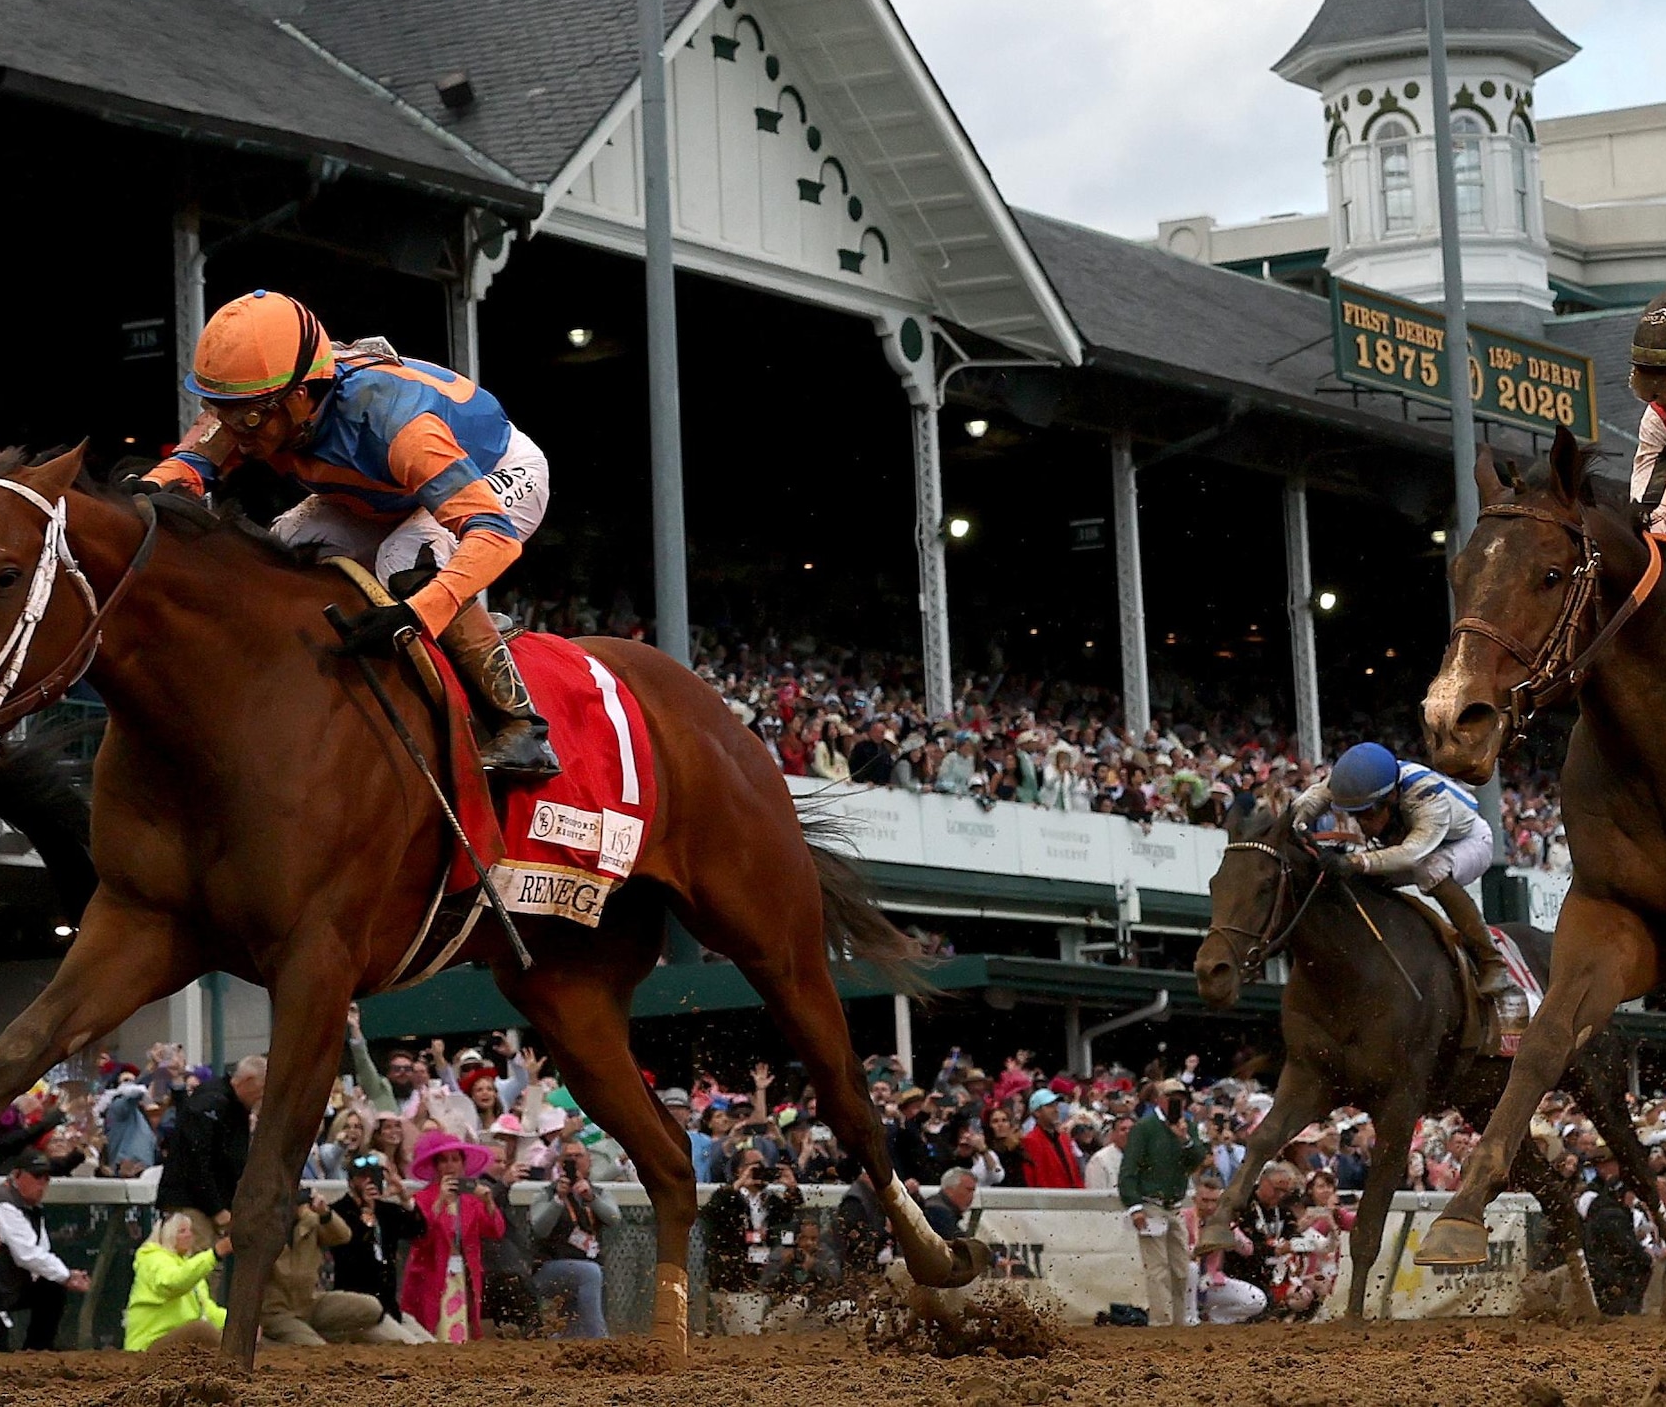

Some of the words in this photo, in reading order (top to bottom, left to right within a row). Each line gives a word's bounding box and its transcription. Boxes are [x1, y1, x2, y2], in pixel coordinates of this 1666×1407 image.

[1342, 300, 1390, 335] FIRST
[1394, 317, 1444, 352] DERBY
[1355, 334, 1439, 387] 1875
[1527, 357, 1582, 391] DERBY
[1497, 375, 1575, 426] 2026
[583, 655, 640, 805] 1
[611, 830, 632, 855] 152
